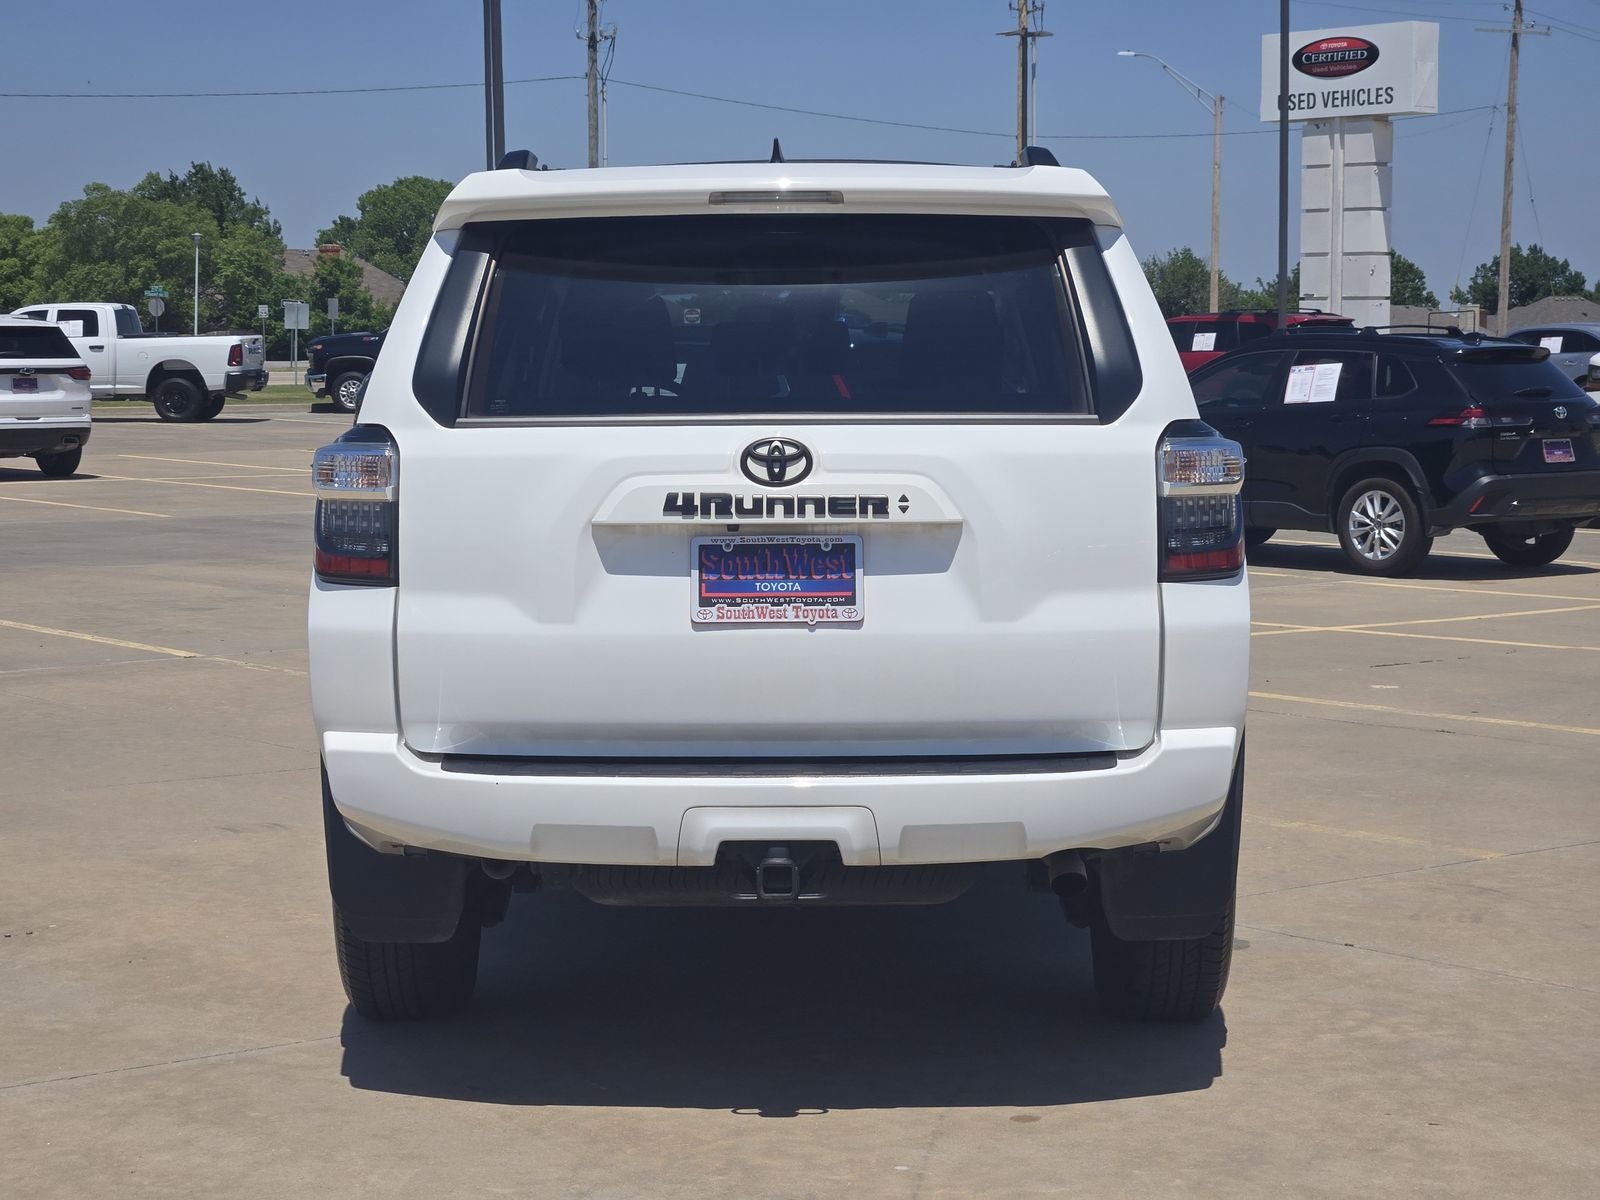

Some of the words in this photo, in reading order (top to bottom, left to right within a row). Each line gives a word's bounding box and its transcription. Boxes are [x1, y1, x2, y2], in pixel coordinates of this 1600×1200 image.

[1328, 41, 1348, 49] TOYOTA
[1302, 50, 1368, 64] CERTIFIED
[1278, 92, 1317, 111] SED
[1321, 86, 1394, 109] VEHICLES
[663, 492, 889, 519] 4RUNNER
[710, 536, 843, 544] www.SouthWestToyota.com
[755, 582, 801, 592] TOYOTA
[716, 604, 788, 620] SouthWest
[792, 605, 838, 623] Toyota
